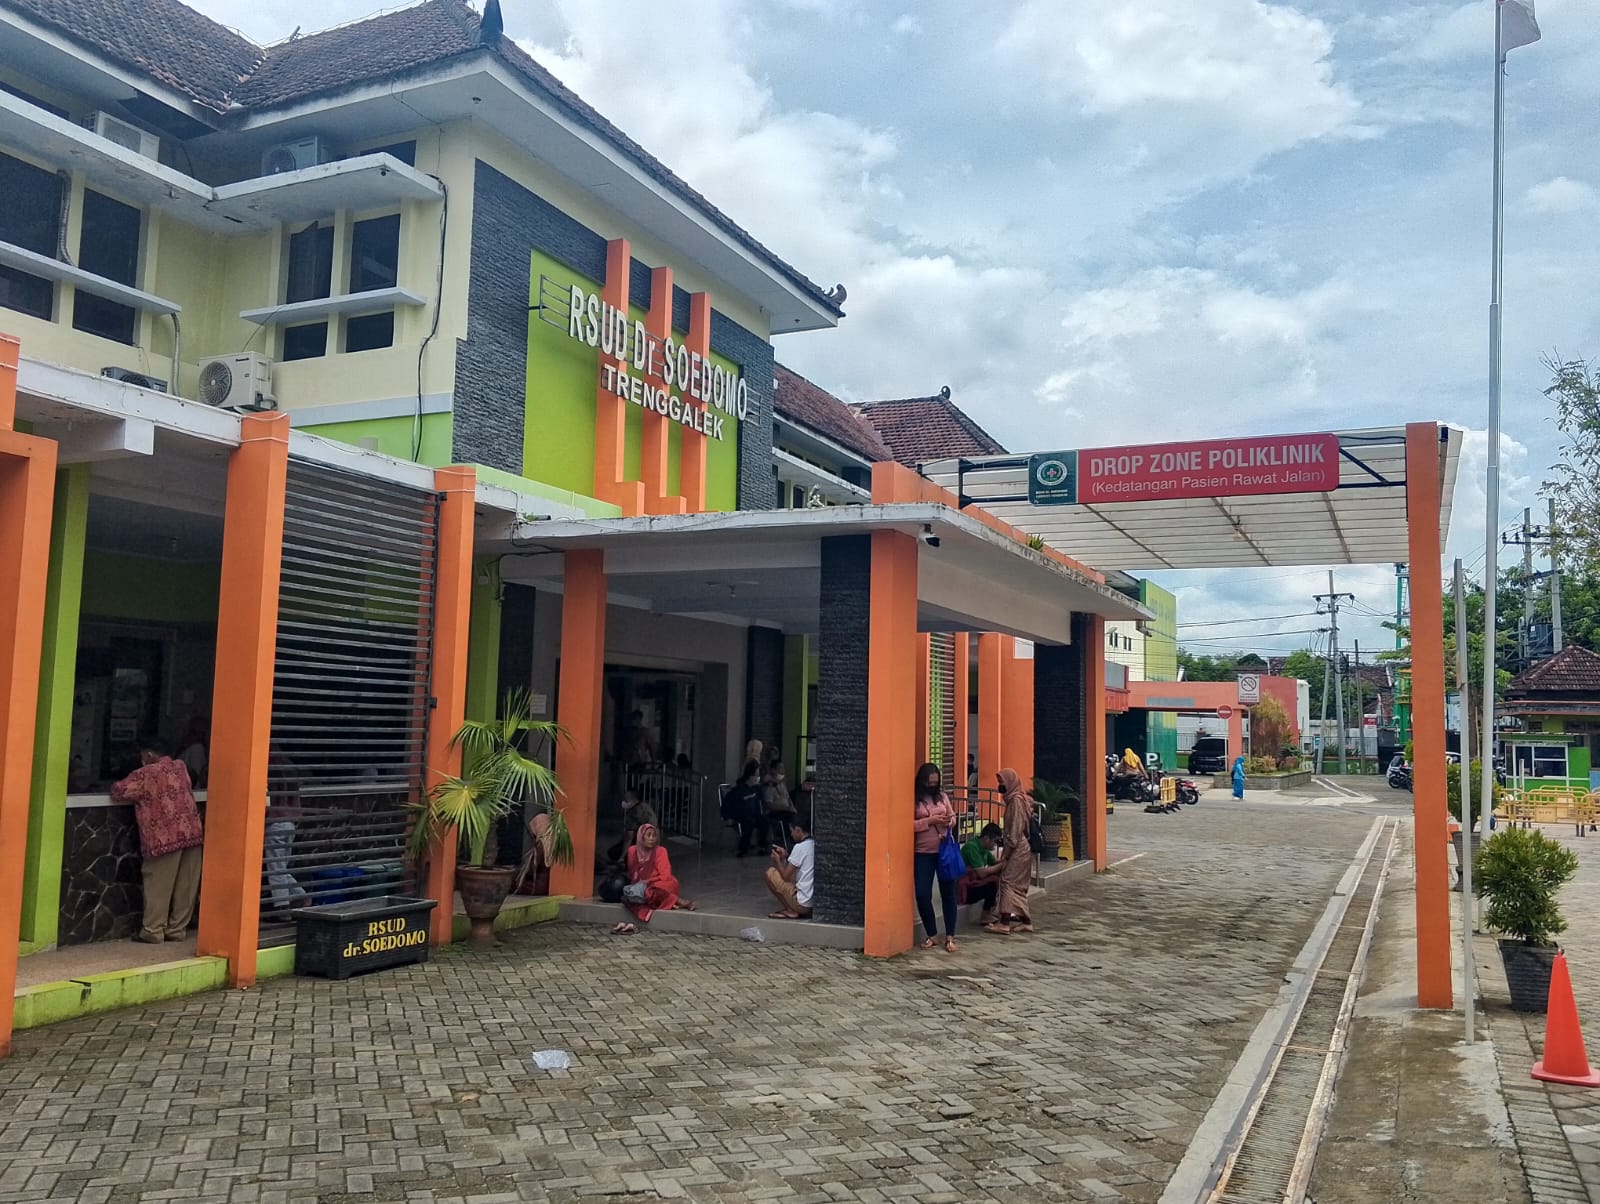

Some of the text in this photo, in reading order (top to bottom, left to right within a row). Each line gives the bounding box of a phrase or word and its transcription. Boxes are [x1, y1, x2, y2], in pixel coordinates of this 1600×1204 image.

[569, 285, 748, 421] RSUD Dr SOEDOMO
[604, 363, 724, 441] TRENGGALEK
[1090, 443, 1325, 477] DROP ZONE POLIKLINIK
[1091, 468, 1326, 497] (Kedatangan Pasien Rawat Jalan)
[1146, 753, 1158, 765] P
[368, 918, 405, 936] RSUD
